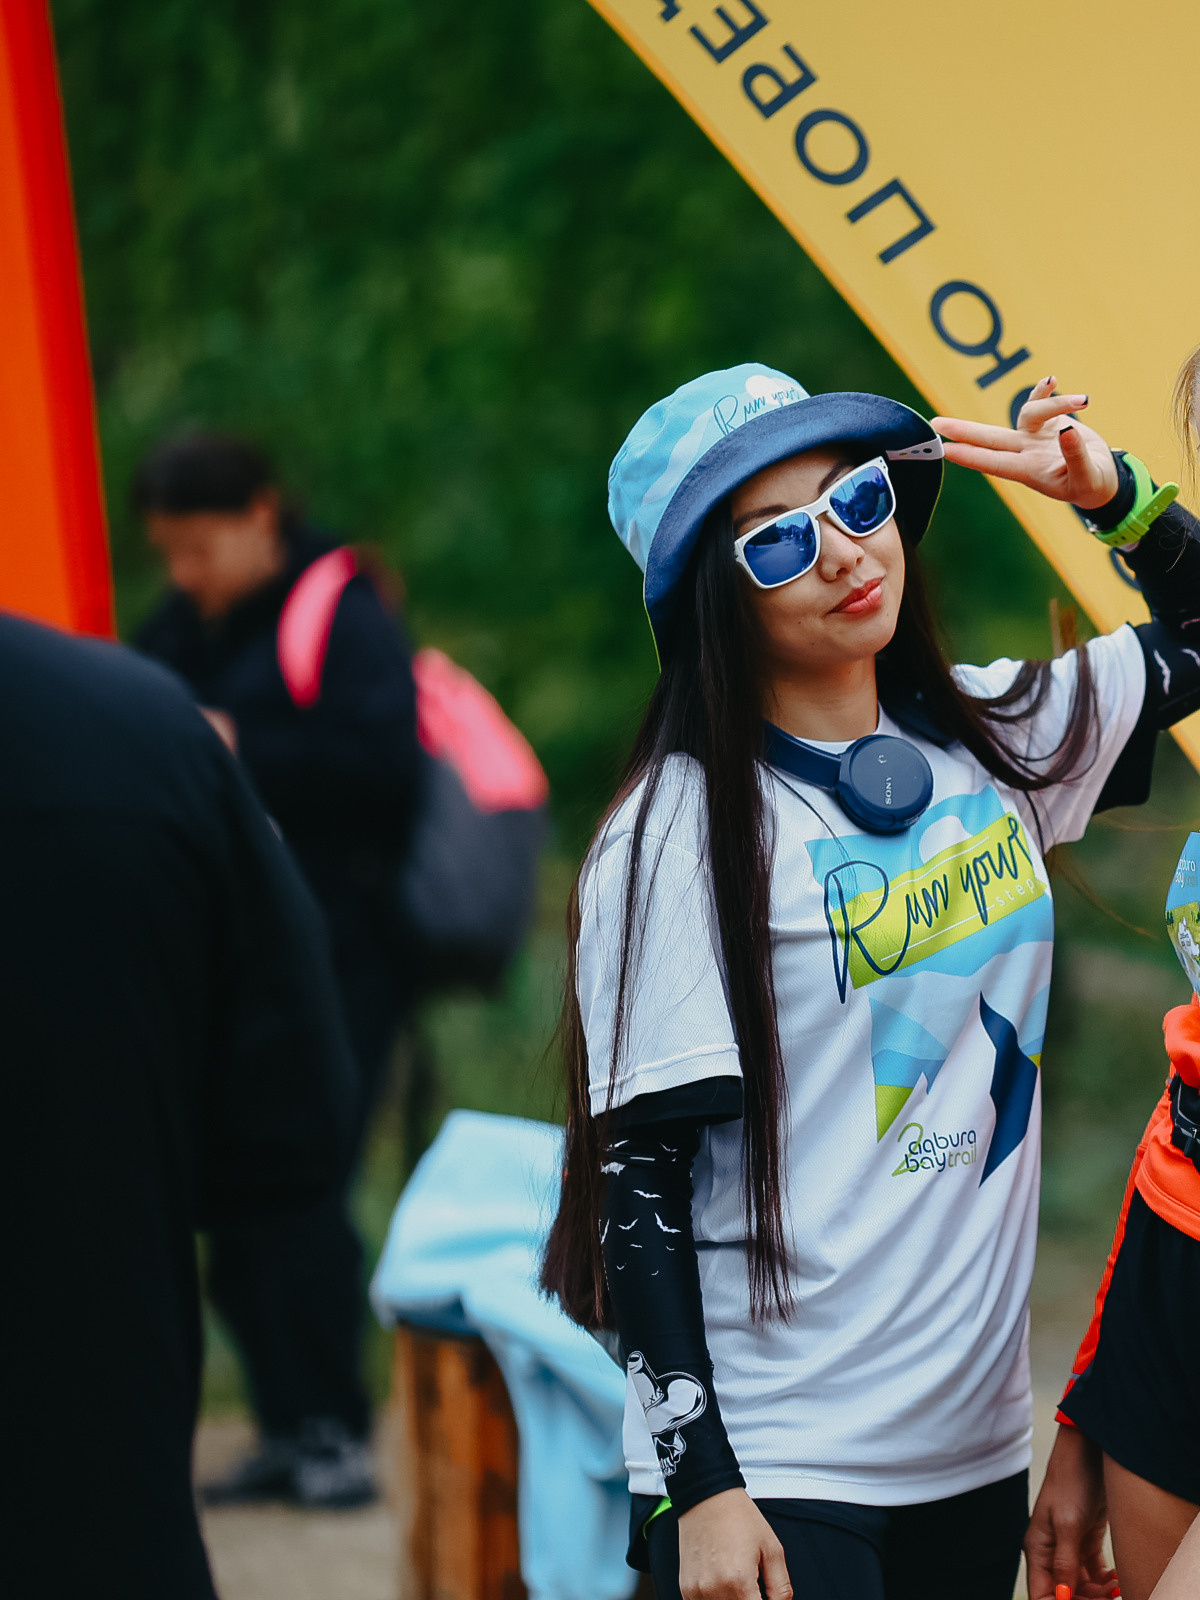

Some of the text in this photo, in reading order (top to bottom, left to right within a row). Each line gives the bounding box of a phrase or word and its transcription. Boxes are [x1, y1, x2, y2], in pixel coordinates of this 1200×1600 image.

[884, 776, 893, 805] SONY
[994, 878, 1035, 907] step
[824, 817, 1033, 1004] Run your
[905, 1144, 977, 1173] bay trail
